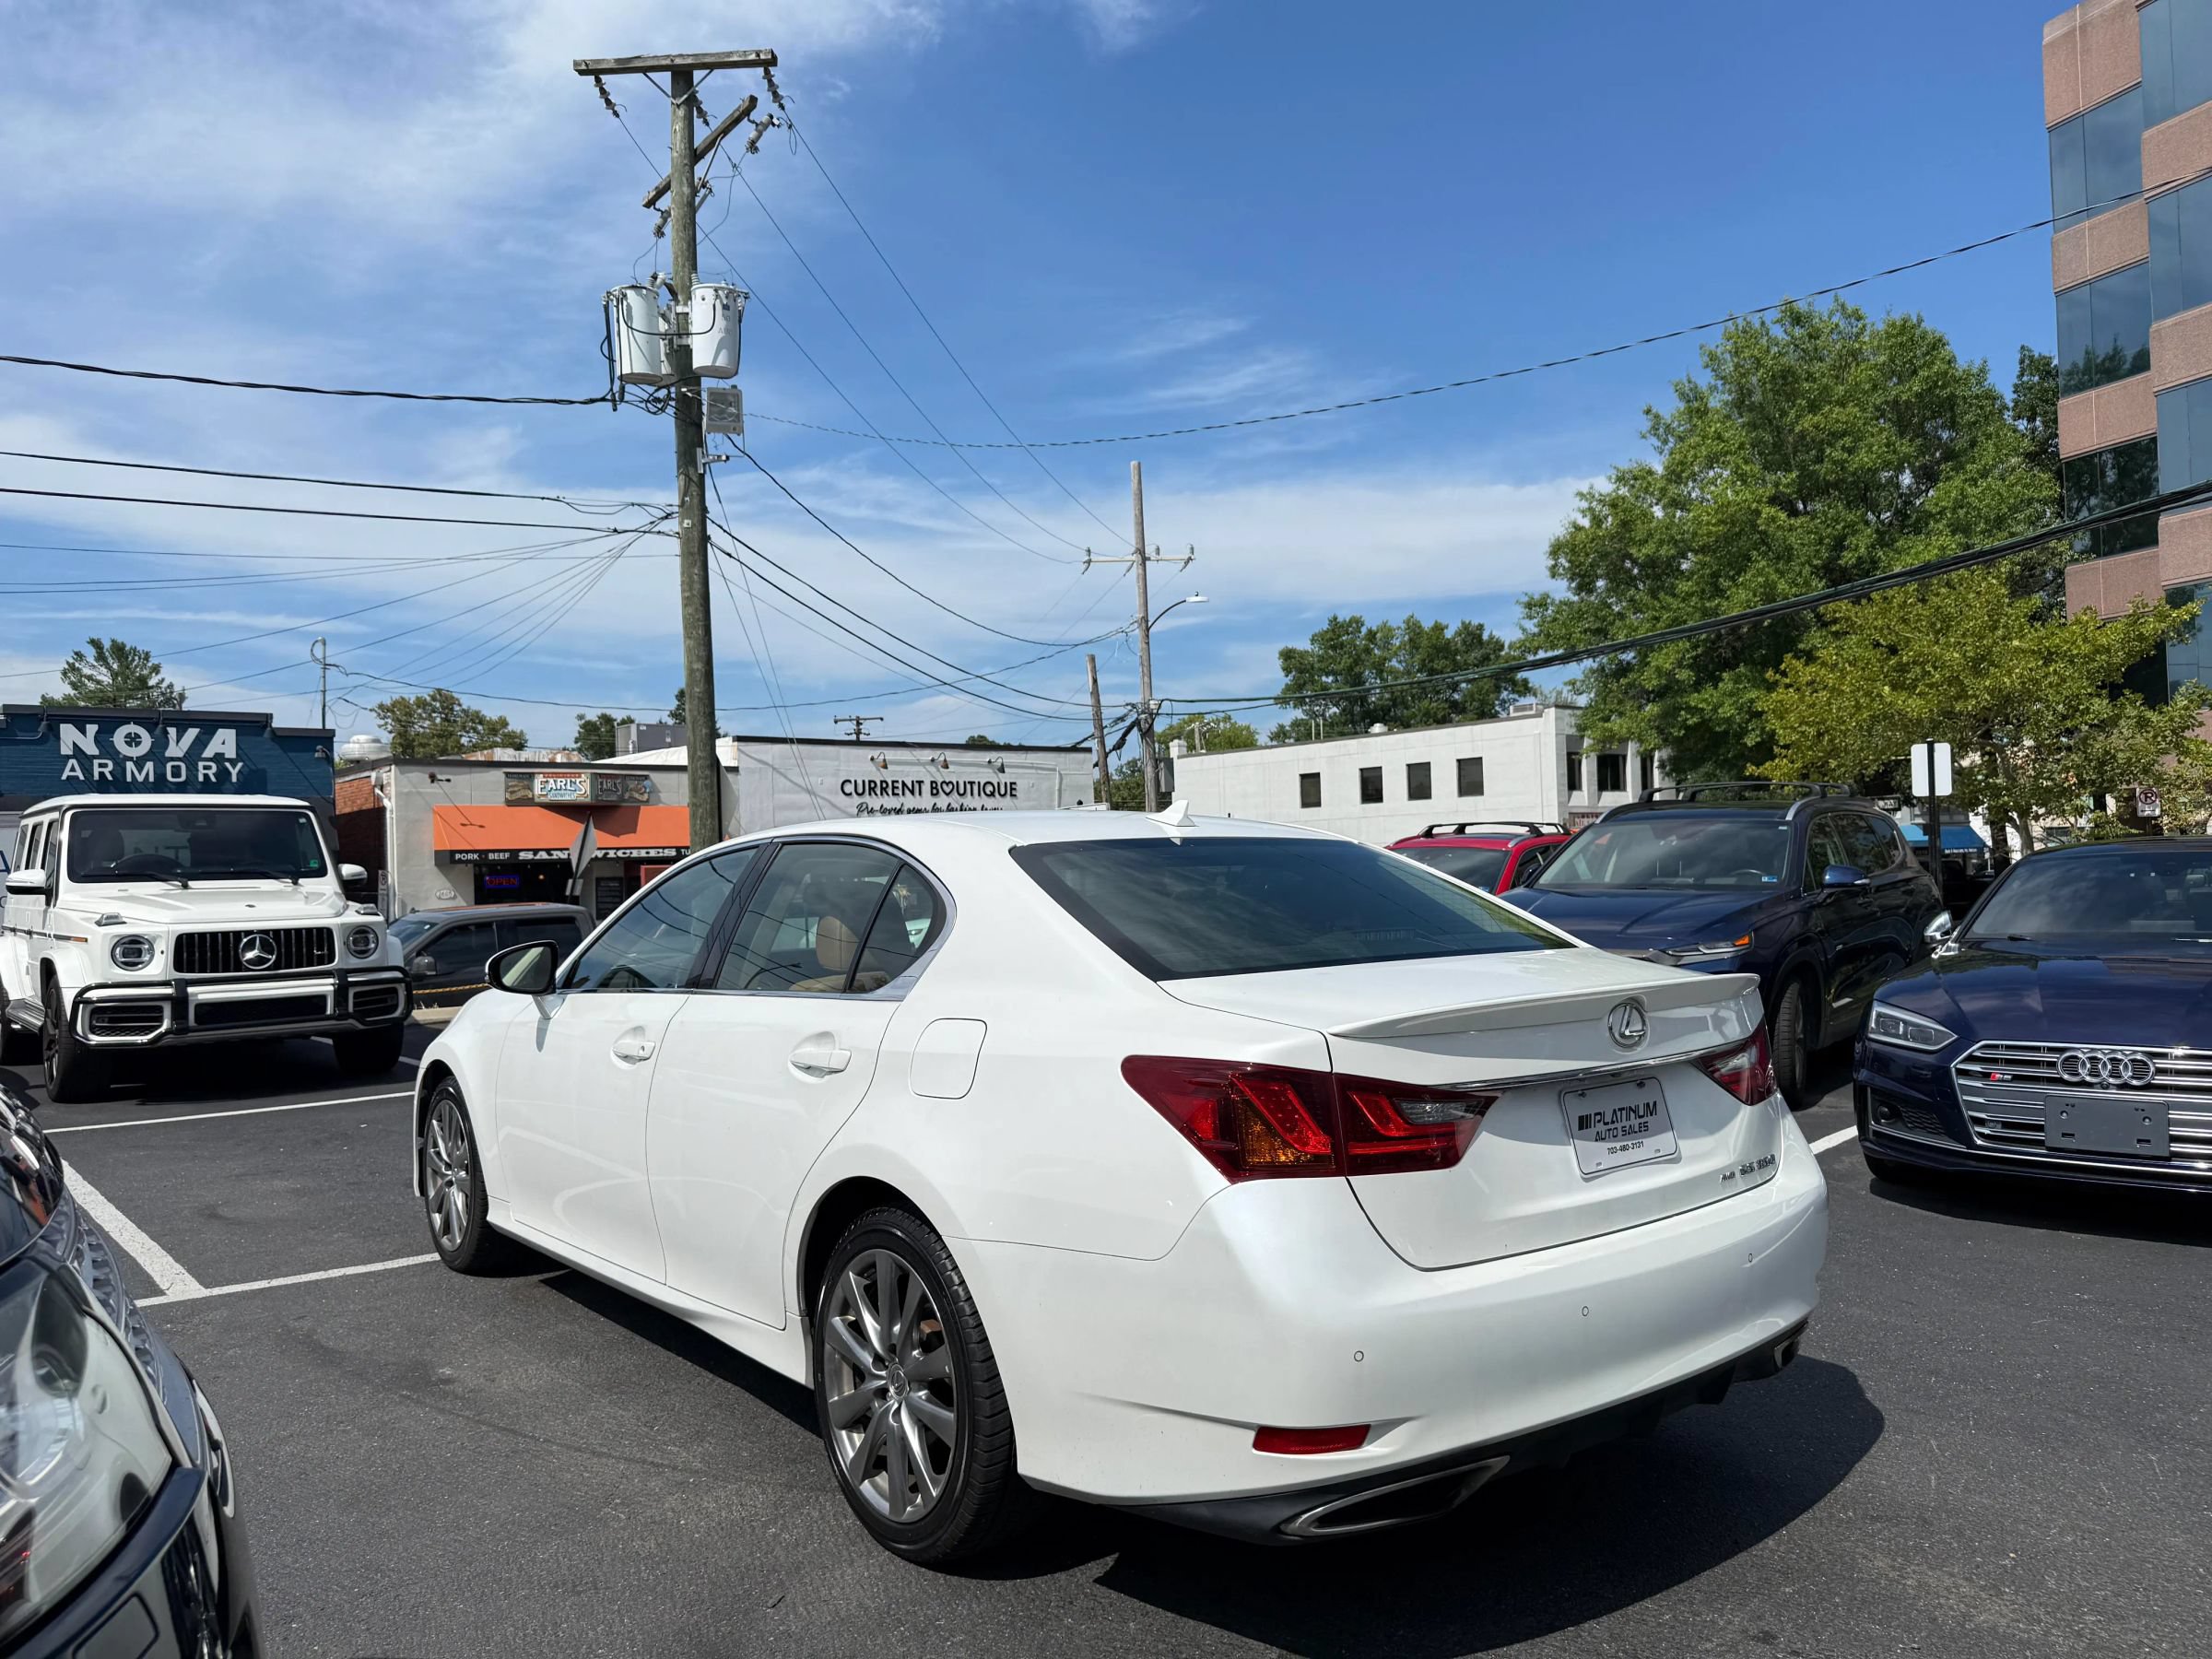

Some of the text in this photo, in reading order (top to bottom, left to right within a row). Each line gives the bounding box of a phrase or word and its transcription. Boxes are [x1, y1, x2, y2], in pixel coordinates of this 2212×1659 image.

[60, 723, 237, 759] NOVA
[61, 759, 244, 782] ARMORY
[538, 778, 586, 795] EARL'S
[841, 779, 1018, 798] CURRENT BOUTIQUE
[856, 802, 904, 817] Pre-loved
[518, 848, 677, 860] SANWICHES
[487, 877, 518, 886] OPEN
[1594, 1100, 1657, 1128] PLATINUM
[1594, 1121, 1649, 1142] AUTO SALES
